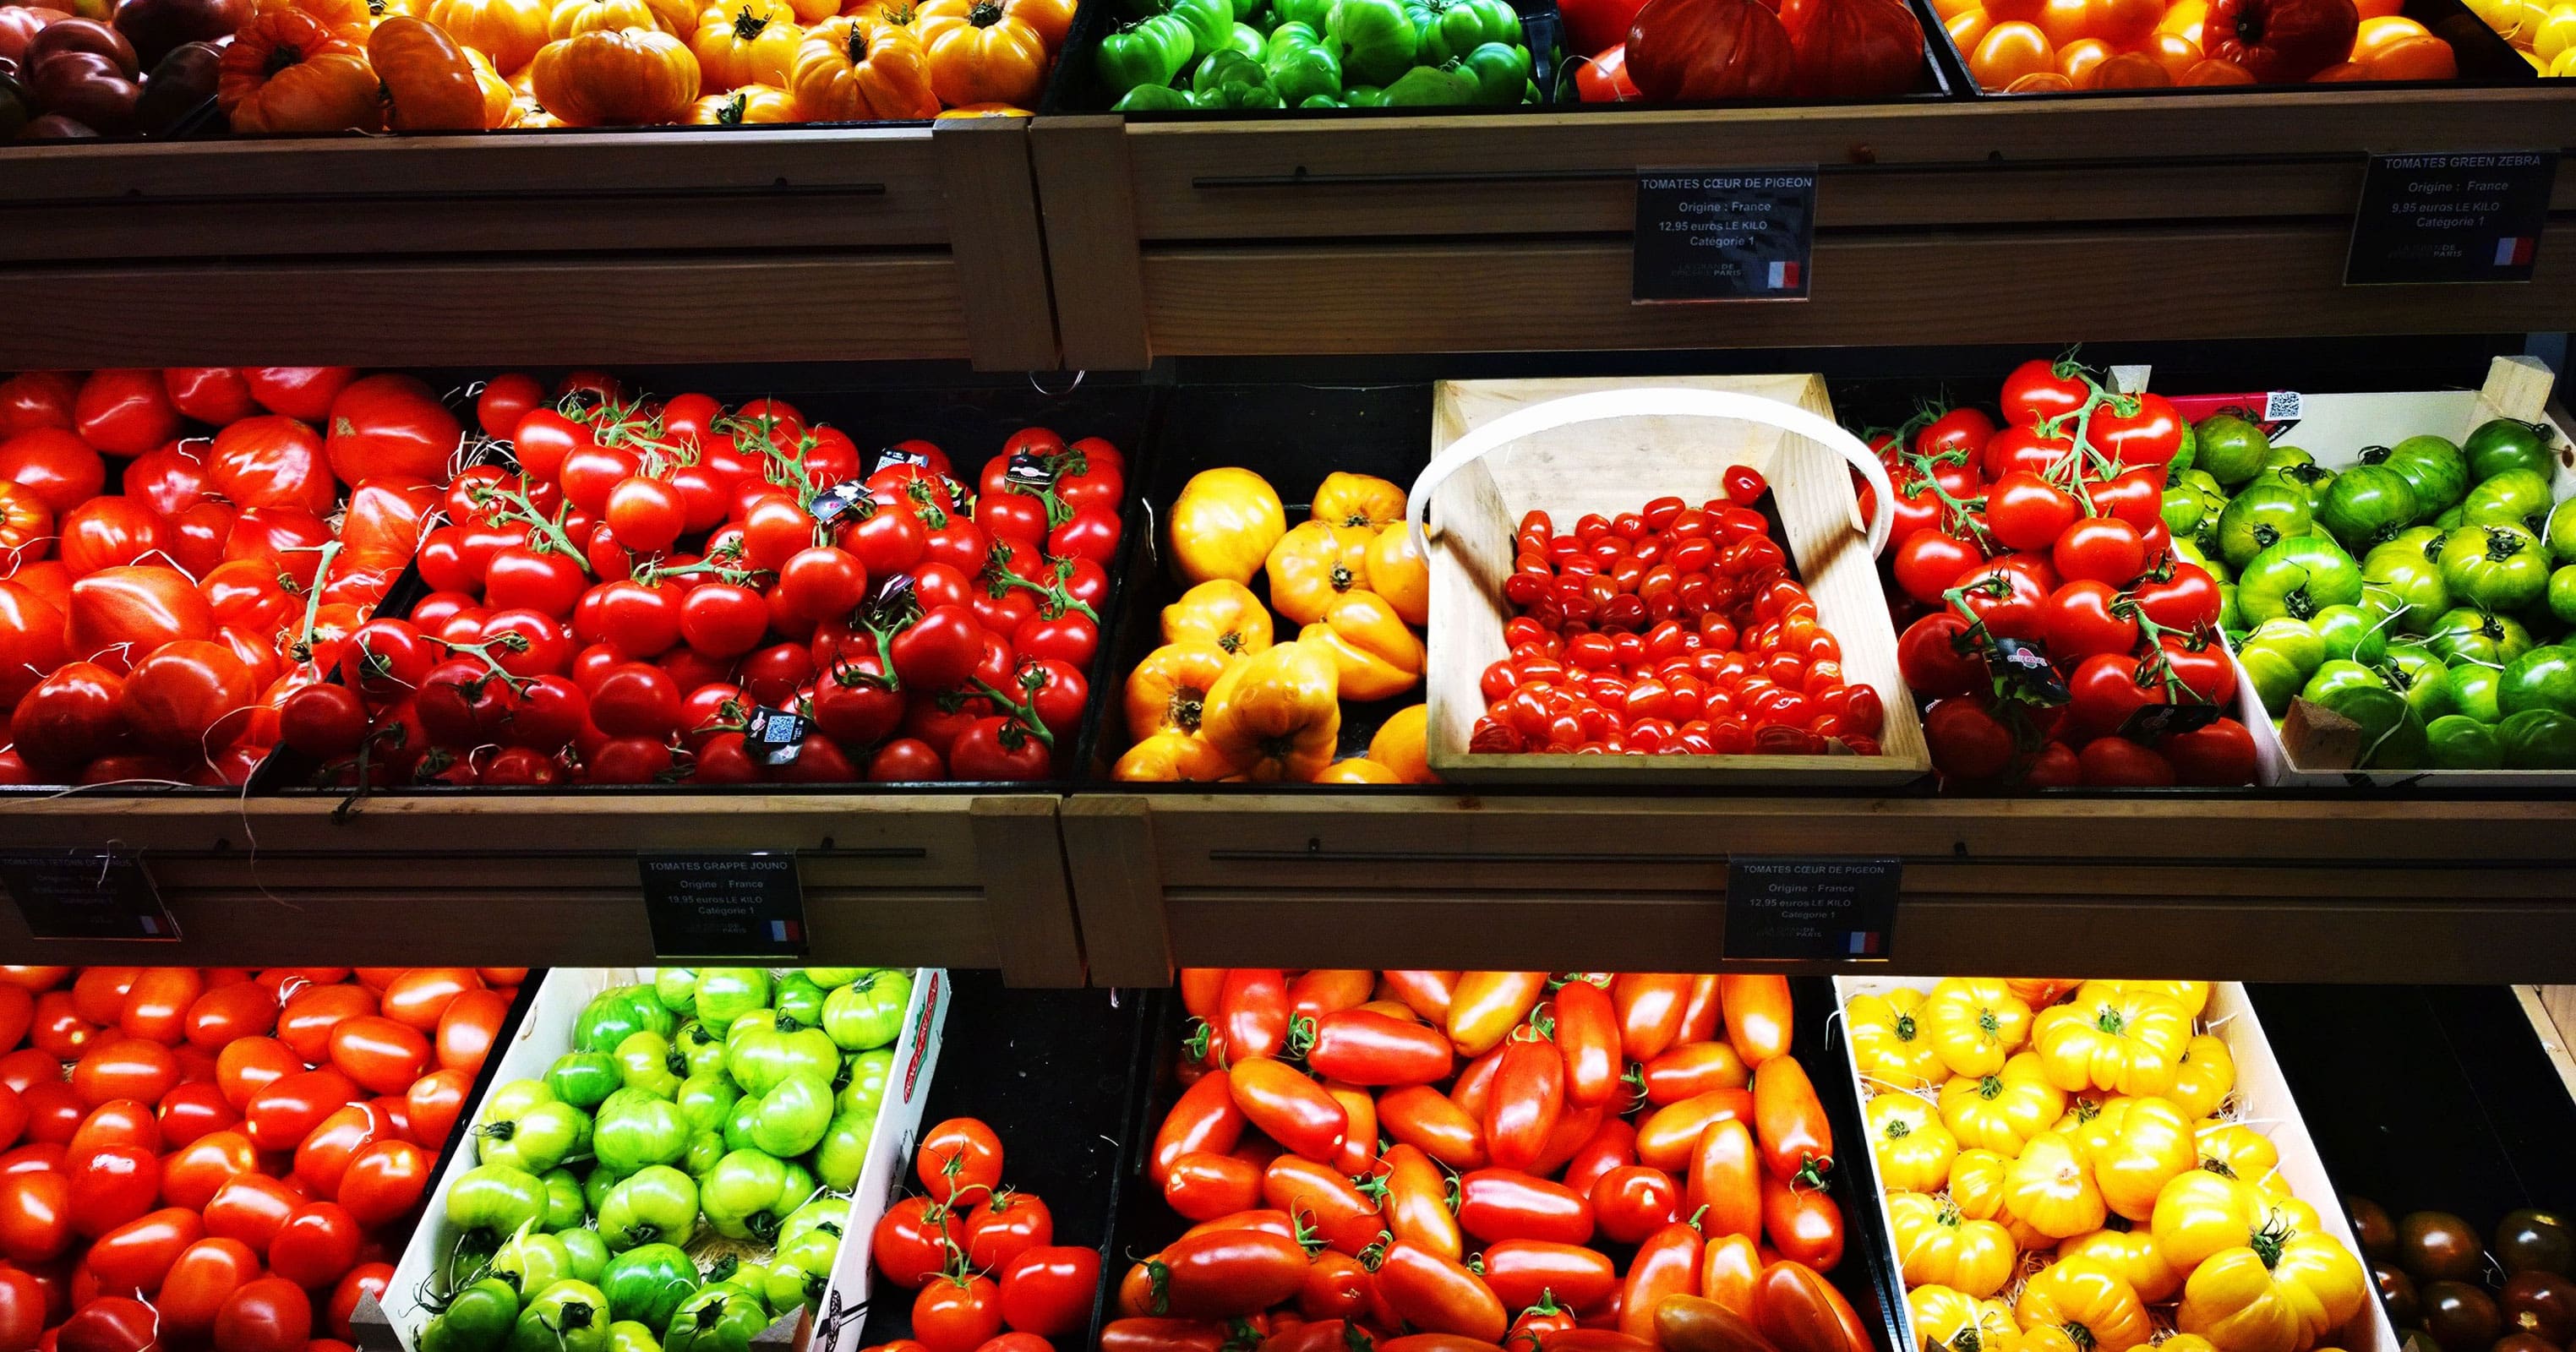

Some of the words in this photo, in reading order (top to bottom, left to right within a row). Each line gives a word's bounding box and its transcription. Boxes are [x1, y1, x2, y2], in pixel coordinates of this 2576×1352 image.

[2385, 157, 2446, 169] TOMATES
[2450, 156, 2495, 168] GREEN
[2497, 155, 2541, 167] ZEBRA
[1641, 178, 1700, 190] TOMATES
[1703, 177, 1741, 189] CŒUR
[1744, 177, 1761, 188] DE
[1765, 177, 1812, 188] PIGEON
[2408, 182, 2453, 195] Origine
[2467, 180, 2508, 192] France
[1678, 202, 1721, 215] Origine
[1731, 201, 1771, 213] France
[2391, 202, 2415, 215] 9,95
[2419, 203, 2453, 213] euros
[2455, 203, 2470, 212] LE
[2472, 202, 2500, 212] KILO
[1658, 221, 1689, 232] 12,95
[1690, 222, 1723, 232] euros
[1725, 221, 1739, 231] LE
[1742, 221, 1768, 231] KILO
[2415, 216, 2474, 229] Catégorie
[2478, 216, 2485, 226] 1
[1690, 236, 1744, 248] Catégorie
[1748, 236, 1755, 245] 1
[649, 861, 701, 871] TOMATES
[703, 861, 748, 871] GRAPPE
[750, 861, 789, 870] JOUNO
[1744, 865, 1791, 874] TOMATES
[1793, 865, 1826, 874] CŒUR
[1828, 865, 1842, 874] DE
[1845, 865, 1885, 874] PIGEON
[679, 880, 718, 891] Origine
[729, 880, 764, 888] France
[1768, 884, 1808, 894] Origine
[1818, 884, 1855, 892] France
[726, 896, 738, 904] LE
[740, 896, 763, 904] KILO
[1749, 898, 1776, 908] 12,95
